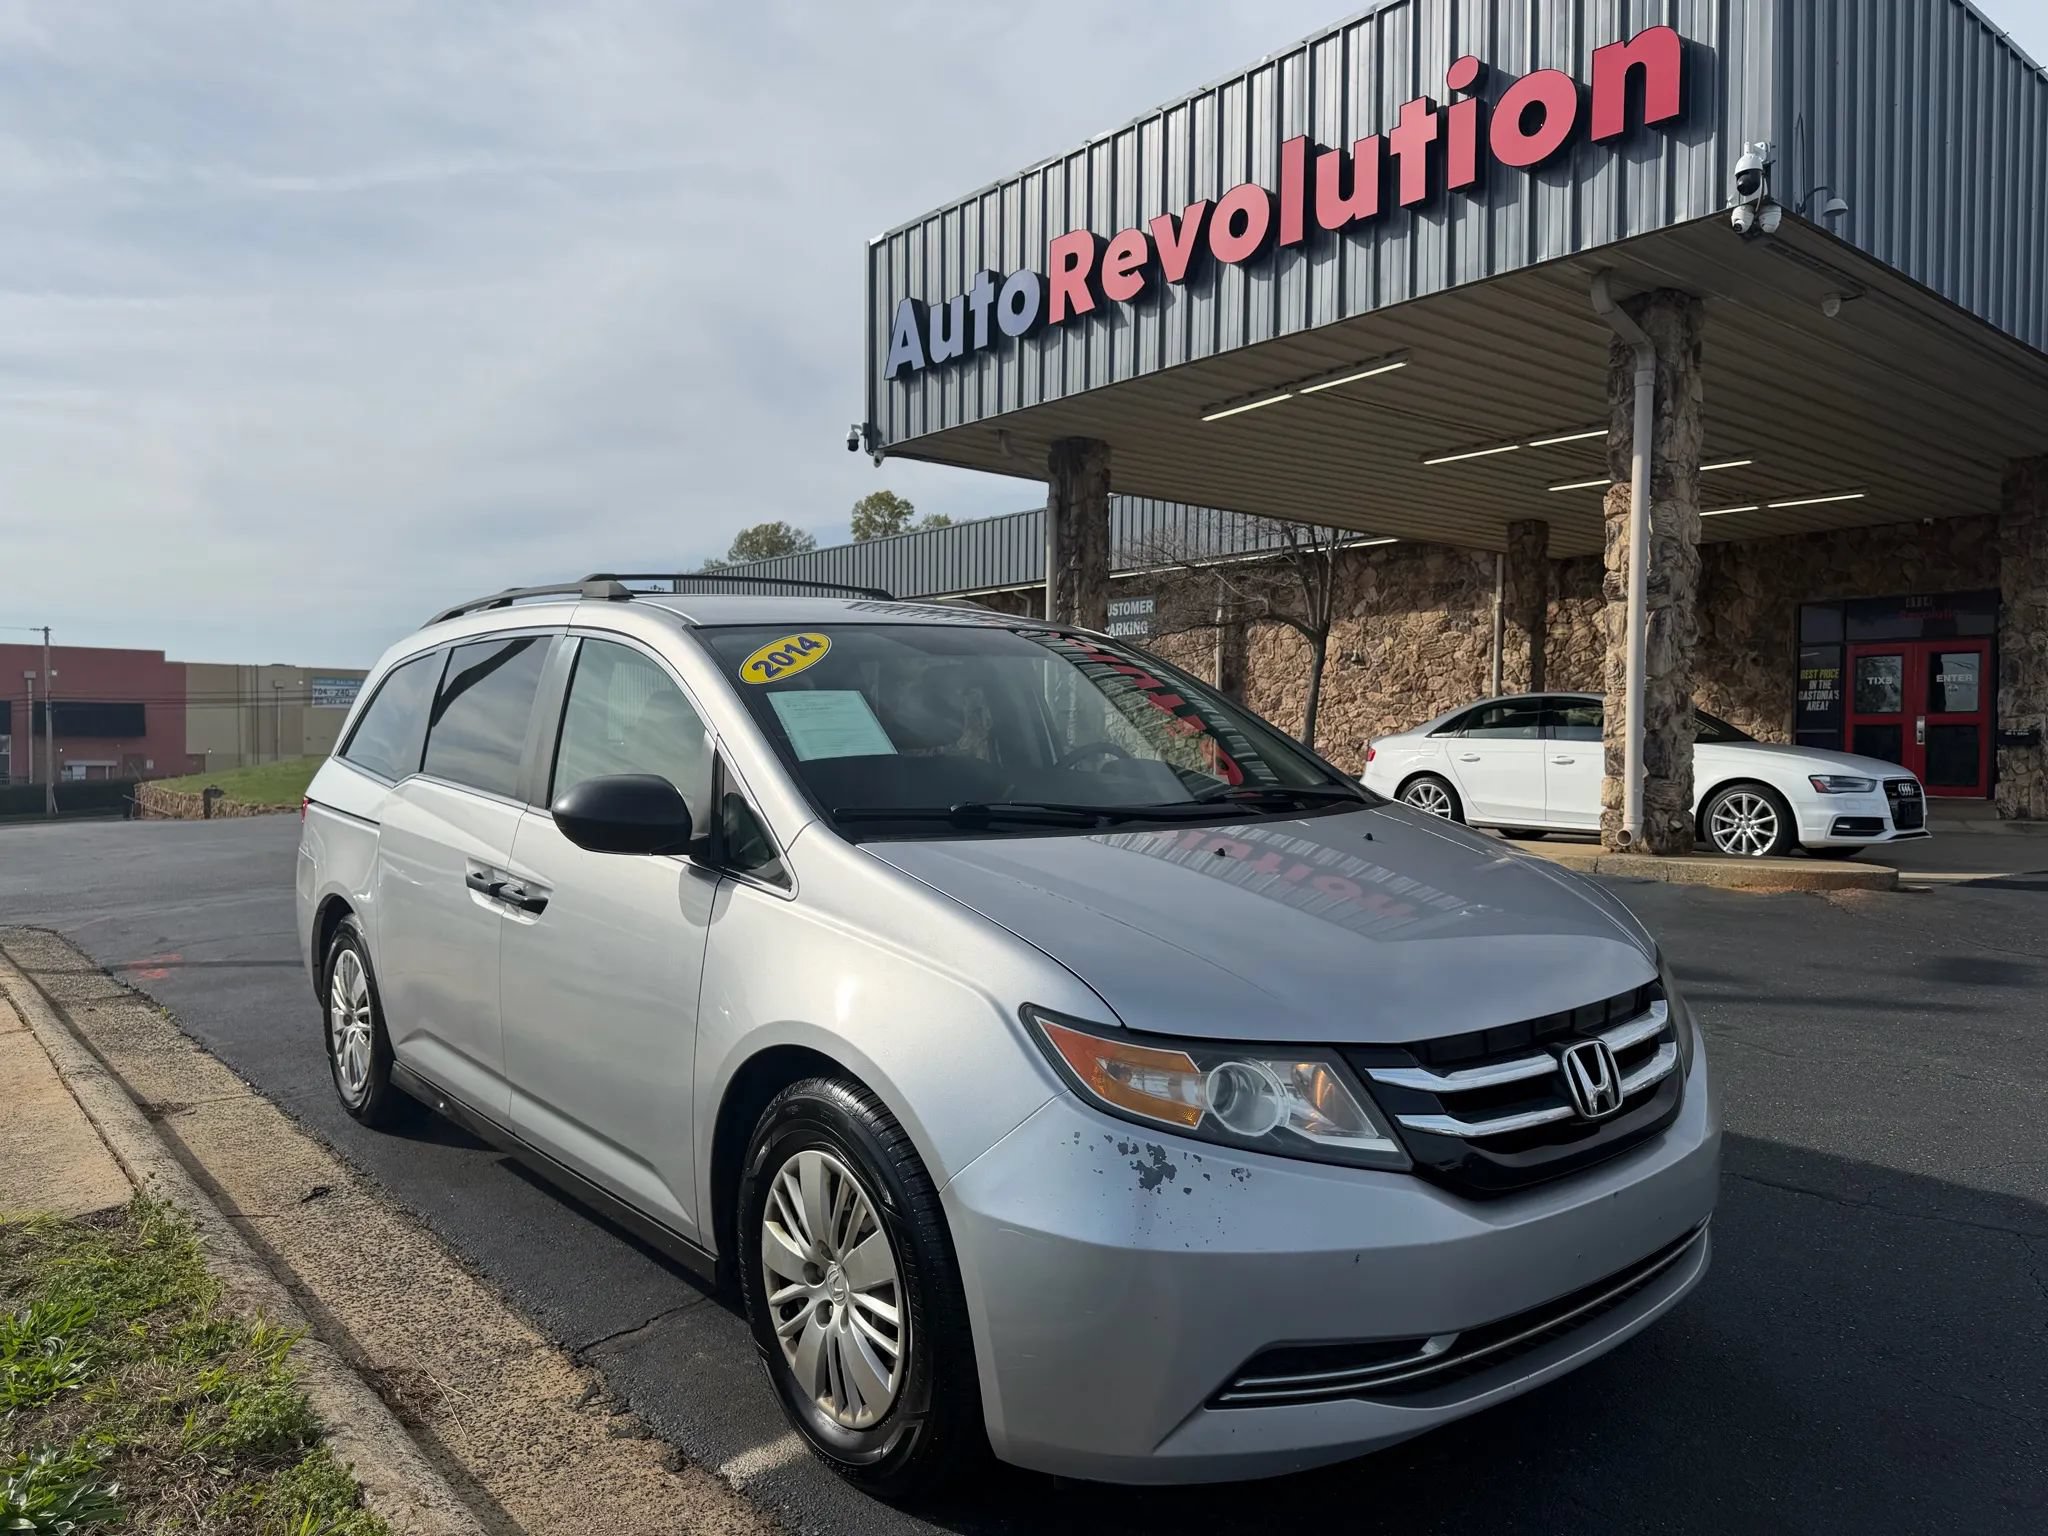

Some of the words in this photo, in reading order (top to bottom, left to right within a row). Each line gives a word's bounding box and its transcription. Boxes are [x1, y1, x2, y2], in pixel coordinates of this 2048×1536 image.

[1107, 600, 1154, 617] USTOMER
[1105, 621, 1149, 637] ARKING
[751, 636, 824, 679] 2014
[1800, 669, 1819, 680] BEST
[1819, 668, 1840, 679] PRICE
[1936, 674, 1972, 683] ENTER
[1809, 680, 1818, 690] IN
[1819, 679, 1832, 689] THE
[1806, 700, 1829, 711] AREA!
